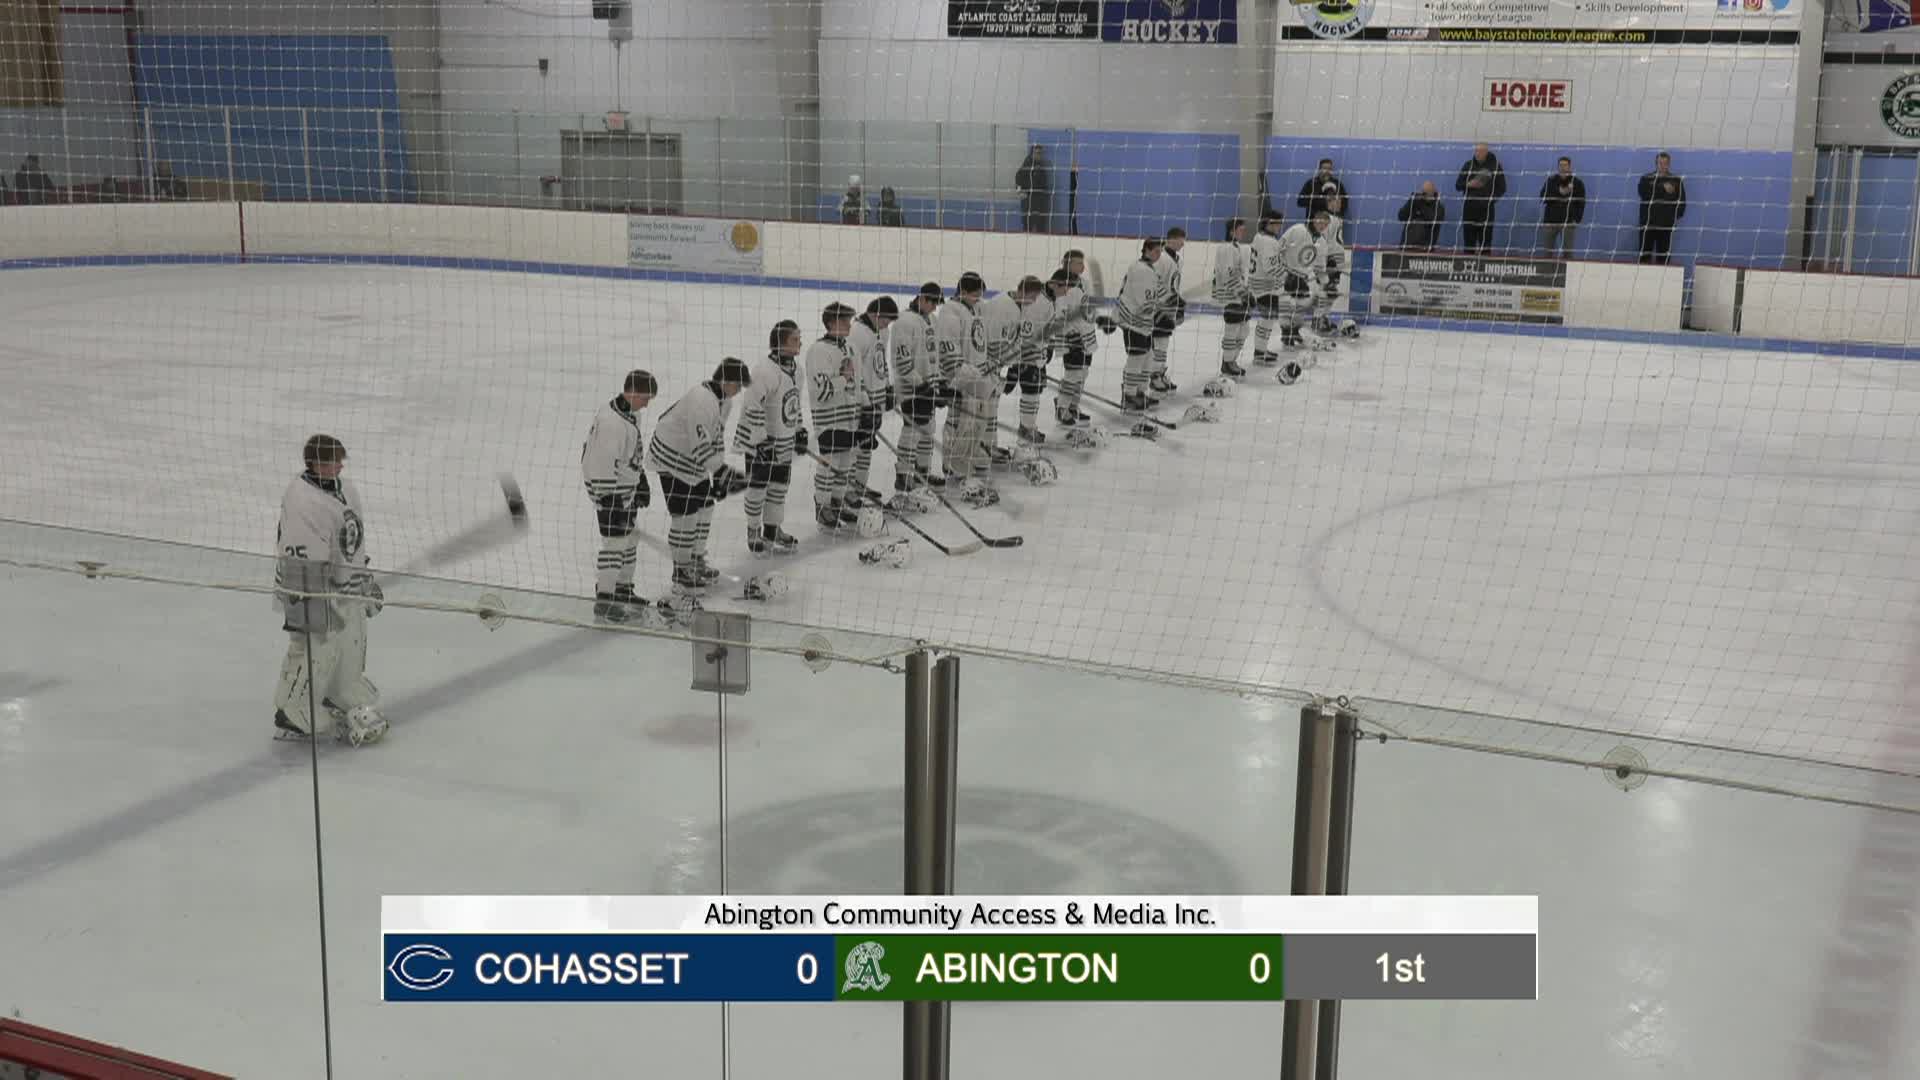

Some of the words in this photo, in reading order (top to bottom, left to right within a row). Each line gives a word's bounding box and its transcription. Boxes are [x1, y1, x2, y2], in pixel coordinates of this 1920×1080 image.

[1488, 2, 1550, 14] Competitive
[1585, 3, 1611, 13] Skills
[1615, 3, 1684, 15] Development
[958, 13, 997, 23] ATLANTIC
[998, 13, 1024, 23] COAST
[1026, 13, 1057, 23] LEAGUE
[1060, 13, 1088, 23] TITLES
[1459, 13, 1495, 24] Hockey
[1497, 13, 1534, 24] League
[1122, 20, 1220, 42] HOCKEY
[1314, 17, 1362, 36] HOCKEY
[1440, 28, 1646, 43] www.baystatehockeyleague.com
[1490, 82, 1566, 108] HOME
[1408, 259, 1454, 273] WARWICK
